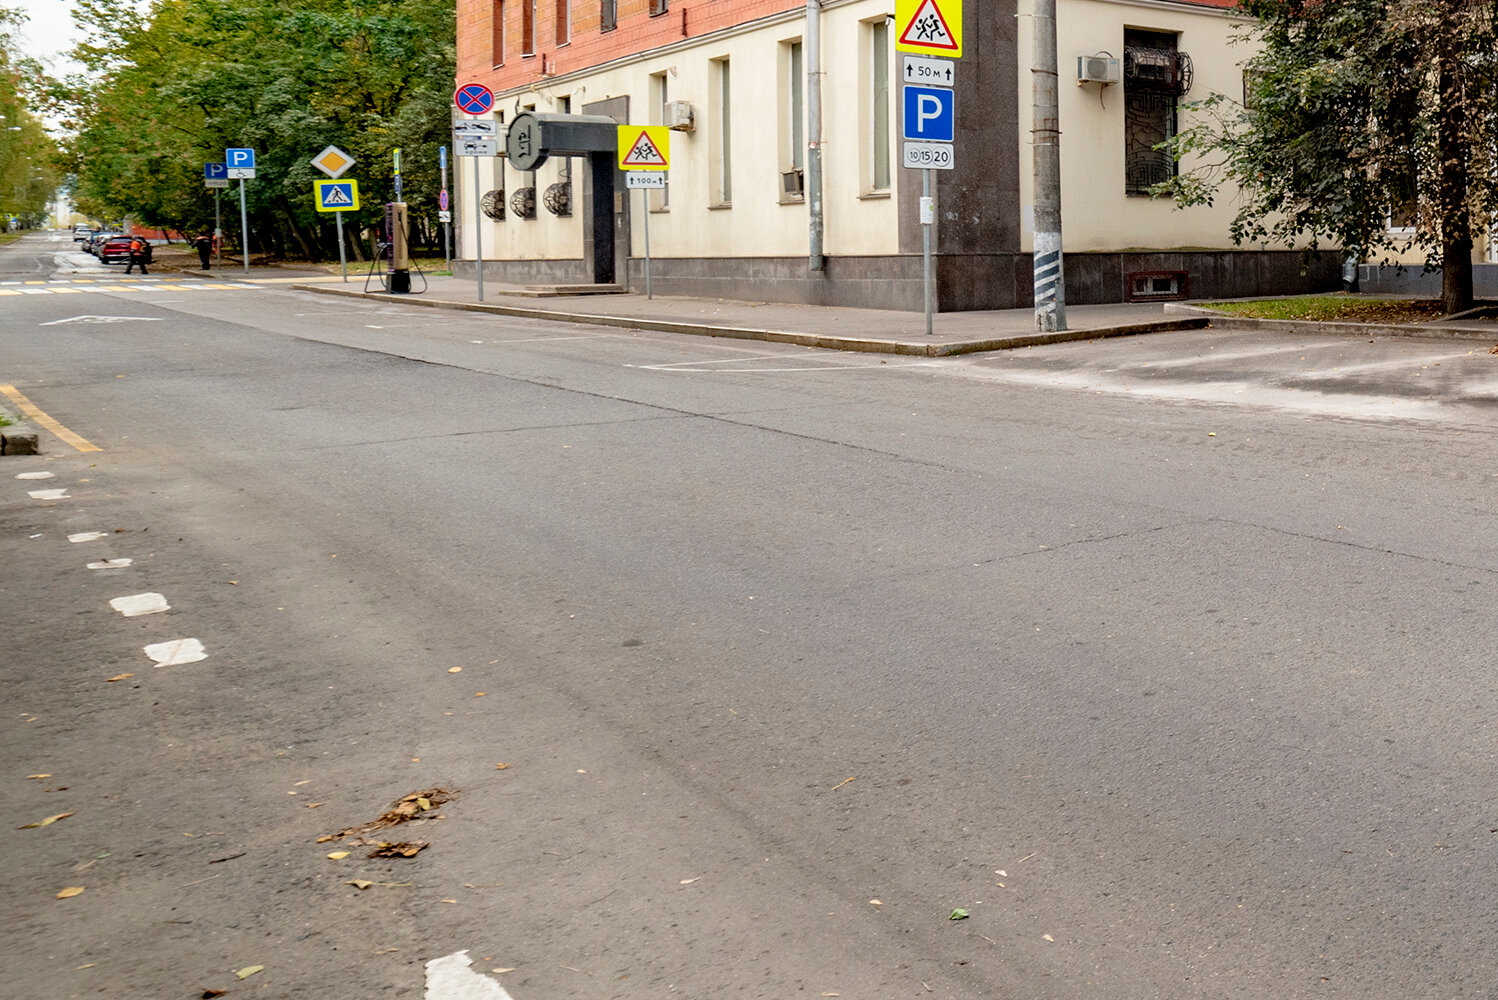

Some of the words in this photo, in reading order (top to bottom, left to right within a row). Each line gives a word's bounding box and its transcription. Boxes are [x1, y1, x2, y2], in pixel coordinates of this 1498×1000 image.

[918, 66, 932, 77] 50
[917, 93, 943, 133] P
[233, 151, 248, 166] P
[910, 151, 919, 159] 10
[921, 151, 931, 161] 15
[934, 151, 949, 163] 20
[211, 163, 224, 177] P
